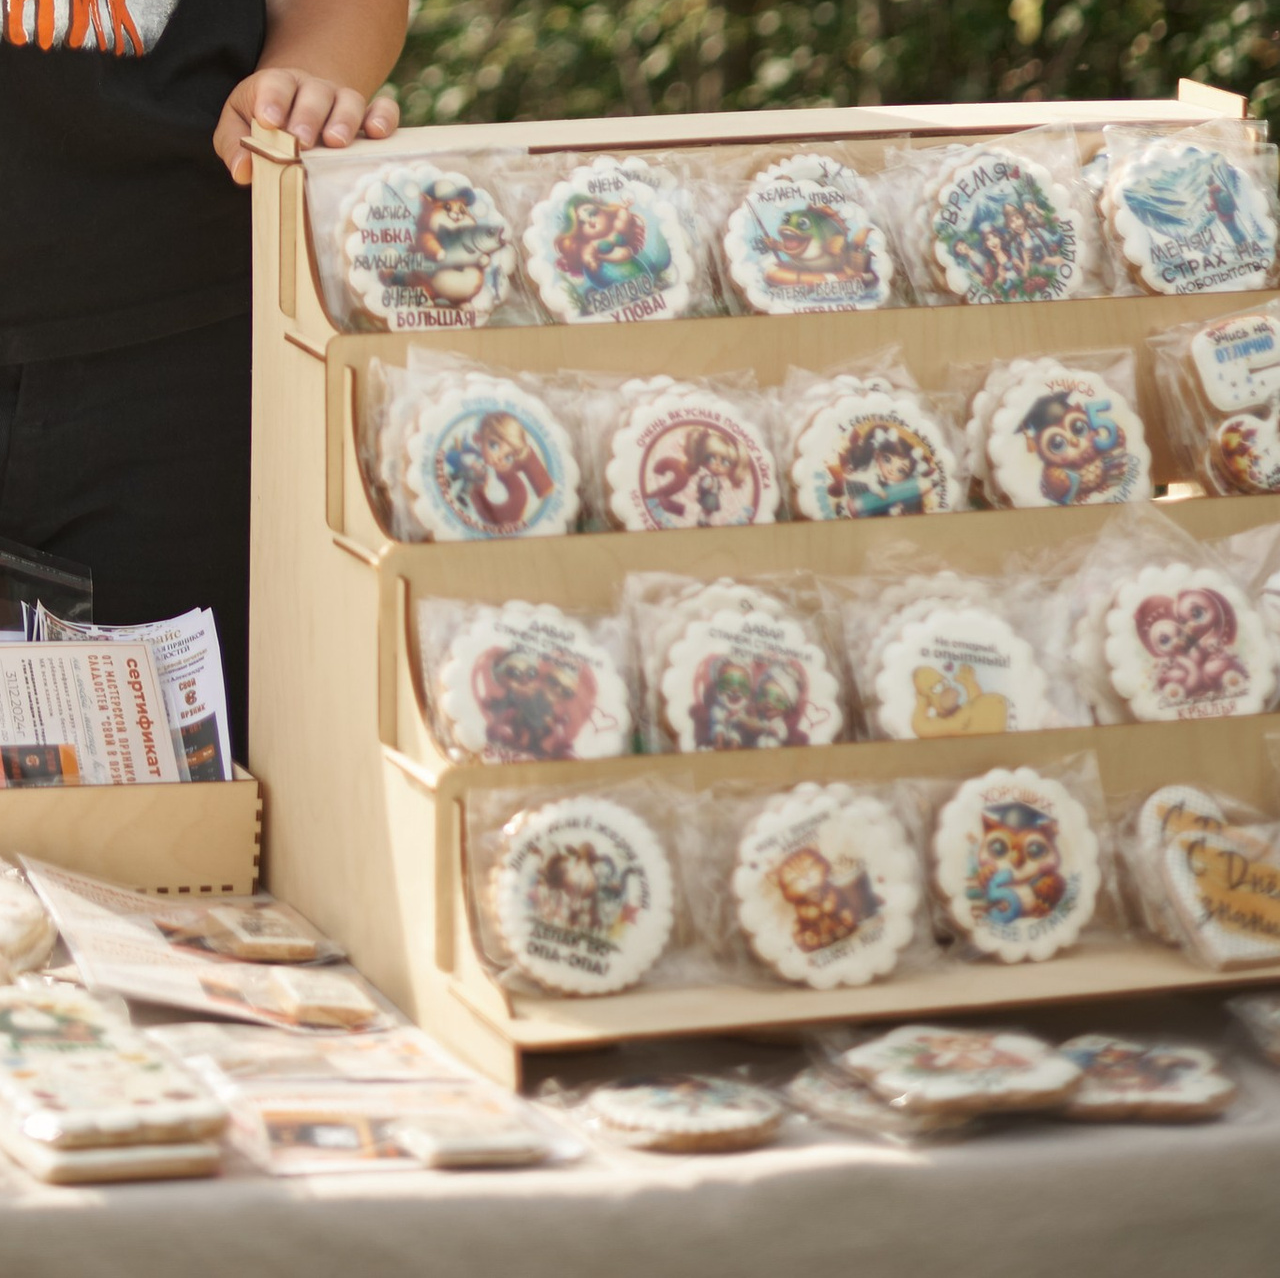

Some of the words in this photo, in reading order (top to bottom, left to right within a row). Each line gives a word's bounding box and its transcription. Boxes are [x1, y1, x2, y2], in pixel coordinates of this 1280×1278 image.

[587, 176, 624, 194] ОЧЕНЬ
[940, 161, 1010, 227] ВРЕМЯ
[360, 228, 414, 244] РЫБКА
[1150, 226, 1217, 264] МЕНЯЙ
[1161, 250, 1228, 284] СТРАХ
[1235, 240, 1264, 261] НА
[381, 286, 429, 309] ОЧЕНЬ
[396, 310, 477, 328] БОЛЬШАЯ!
[1045, 378, 1095, 398] УЧИСЬ
[636, 417, 667, 448] ОЧЕНЬ
[102, 654, 113, 666] ОТ
[88, 654, 109, 711] СЛАДОСТЕЙ
[5, 670, 25, 737] 31.12.2024г
[105, 670, 127, 734] МАСТЕРСКОЙ
[126, 657, 161, 778] сертификат
